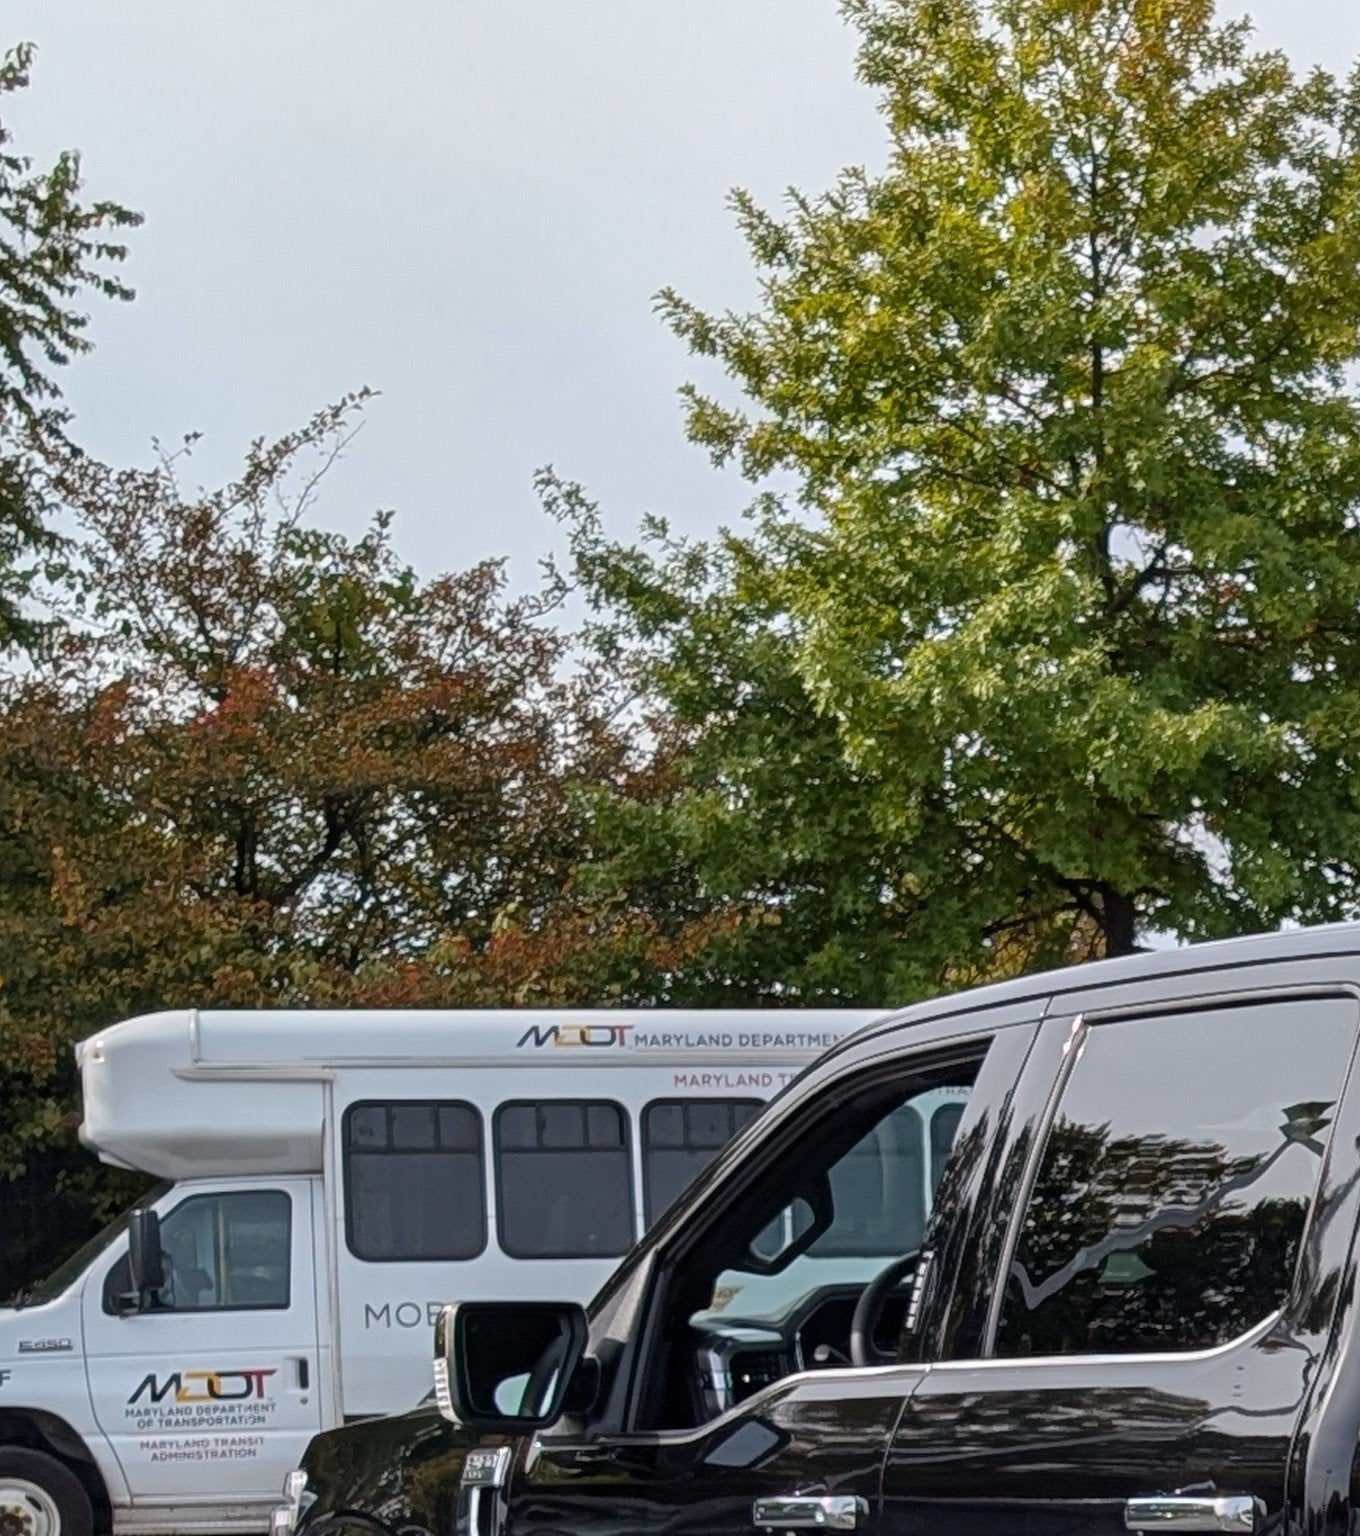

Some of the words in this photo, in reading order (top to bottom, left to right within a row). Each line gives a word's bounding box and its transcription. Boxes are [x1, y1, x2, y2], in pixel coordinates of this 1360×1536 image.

[635, 1034, 733, 1047] MARYLAND
[674, 1073, 773, 1088] MARYLAND
[125, 1407, 192, 1418] MARYLAND
[195, 1403, 277, 1416] DEPARTMENT
[137, 1419, 153, 1430] OF
[158, 1415, 266, 1428] TRANSPORTATION
[140, 1440, 209, 1450] MARYLAND
[214, 1437, 264, 1447] TRANSIT
[151, 1449, 257, 1462] ADMINISTRATION
